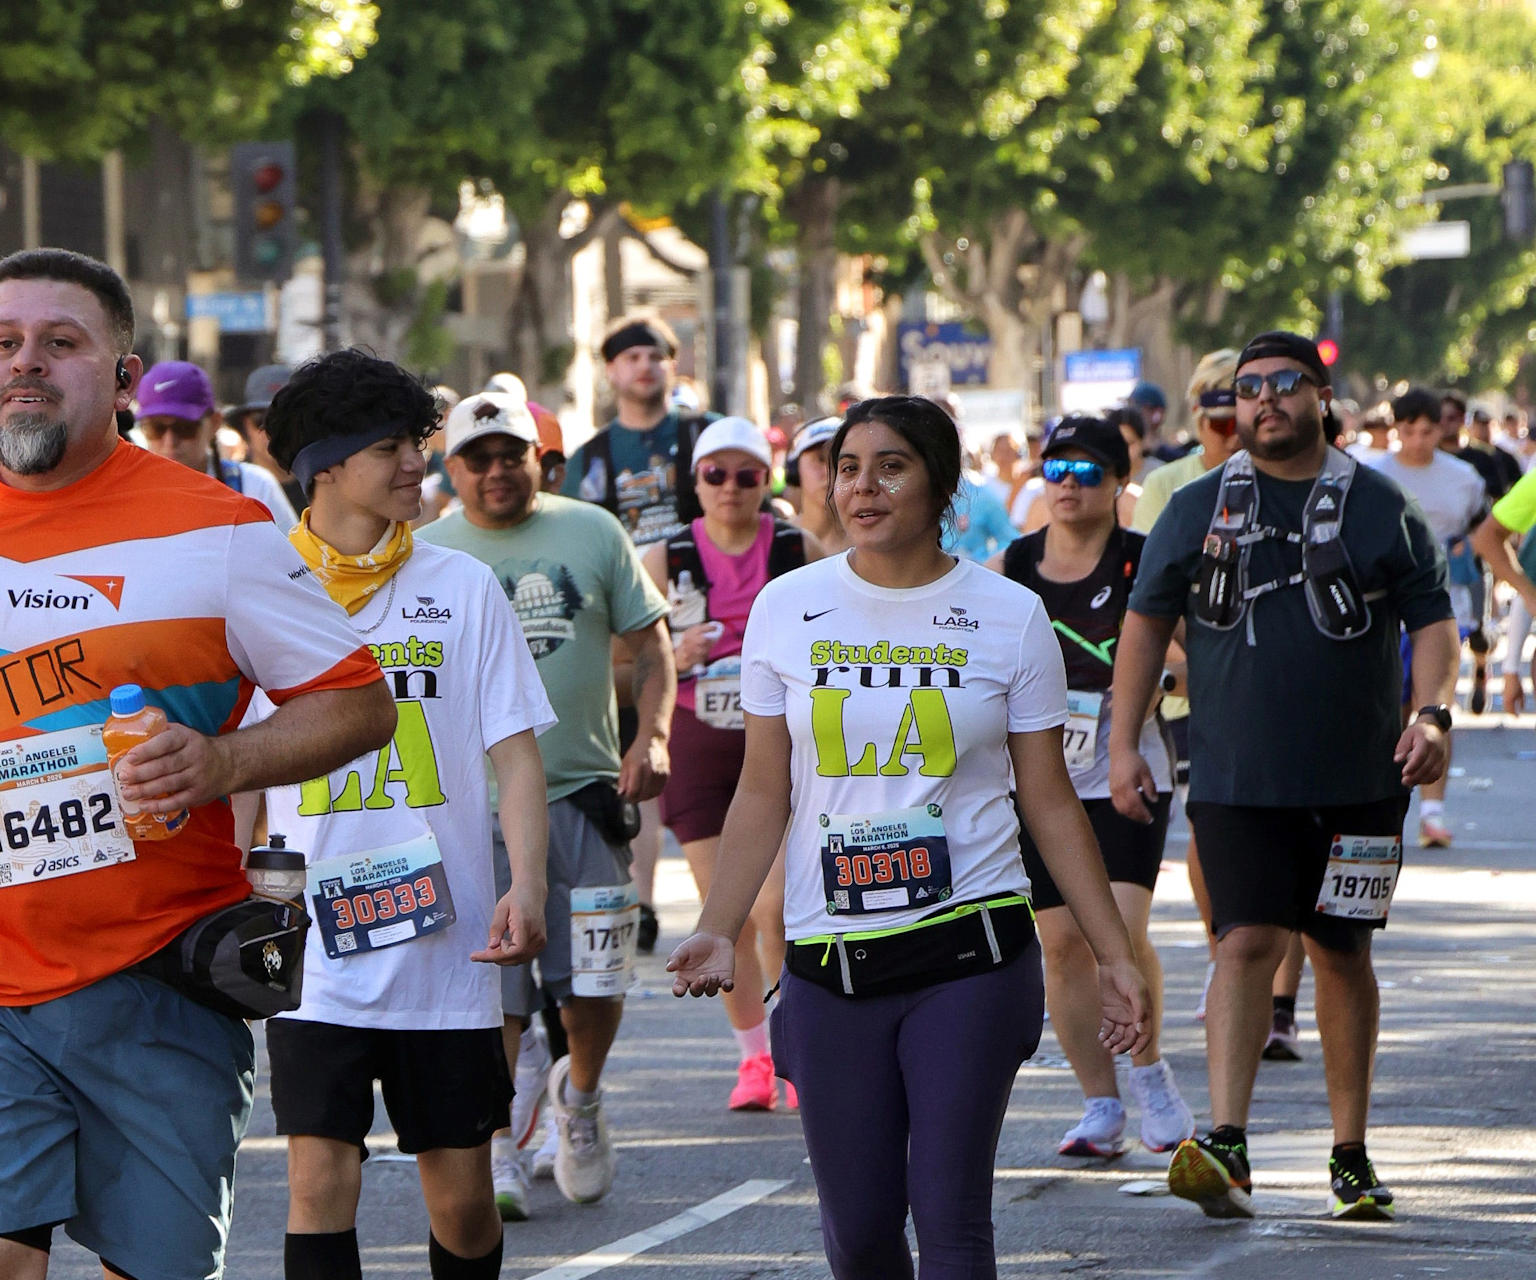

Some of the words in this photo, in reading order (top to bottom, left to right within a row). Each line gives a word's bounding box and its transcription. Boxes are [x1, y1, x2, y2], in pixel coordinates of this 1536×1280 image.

[8, 589, 90, 610] Vision
[401, 607, 453, 620] LA84
[932, 615, 980, 630] LA84
[810, 640, 968, 667] Students
[811, 666, 967, 689] run
[809, 688, 958, 777] LA
[25, 745, 76, 762] ANGELES
[16, 778, 39, 788] MARCH
[852, 830, 909, 843] MARATHON
[871, 822, 907, 833] ANGELES
[47, 855, 80, 872] asics
[350, 867, 365, 875] LOS
[372, 857, 407, 870] ANGELES
[835, 847, 931, 887] 30318
[352, 865, 409, 883] MARATHON
[1332, 874, 1391, 899] 19705
[332, 876, 437, 929] 30333
